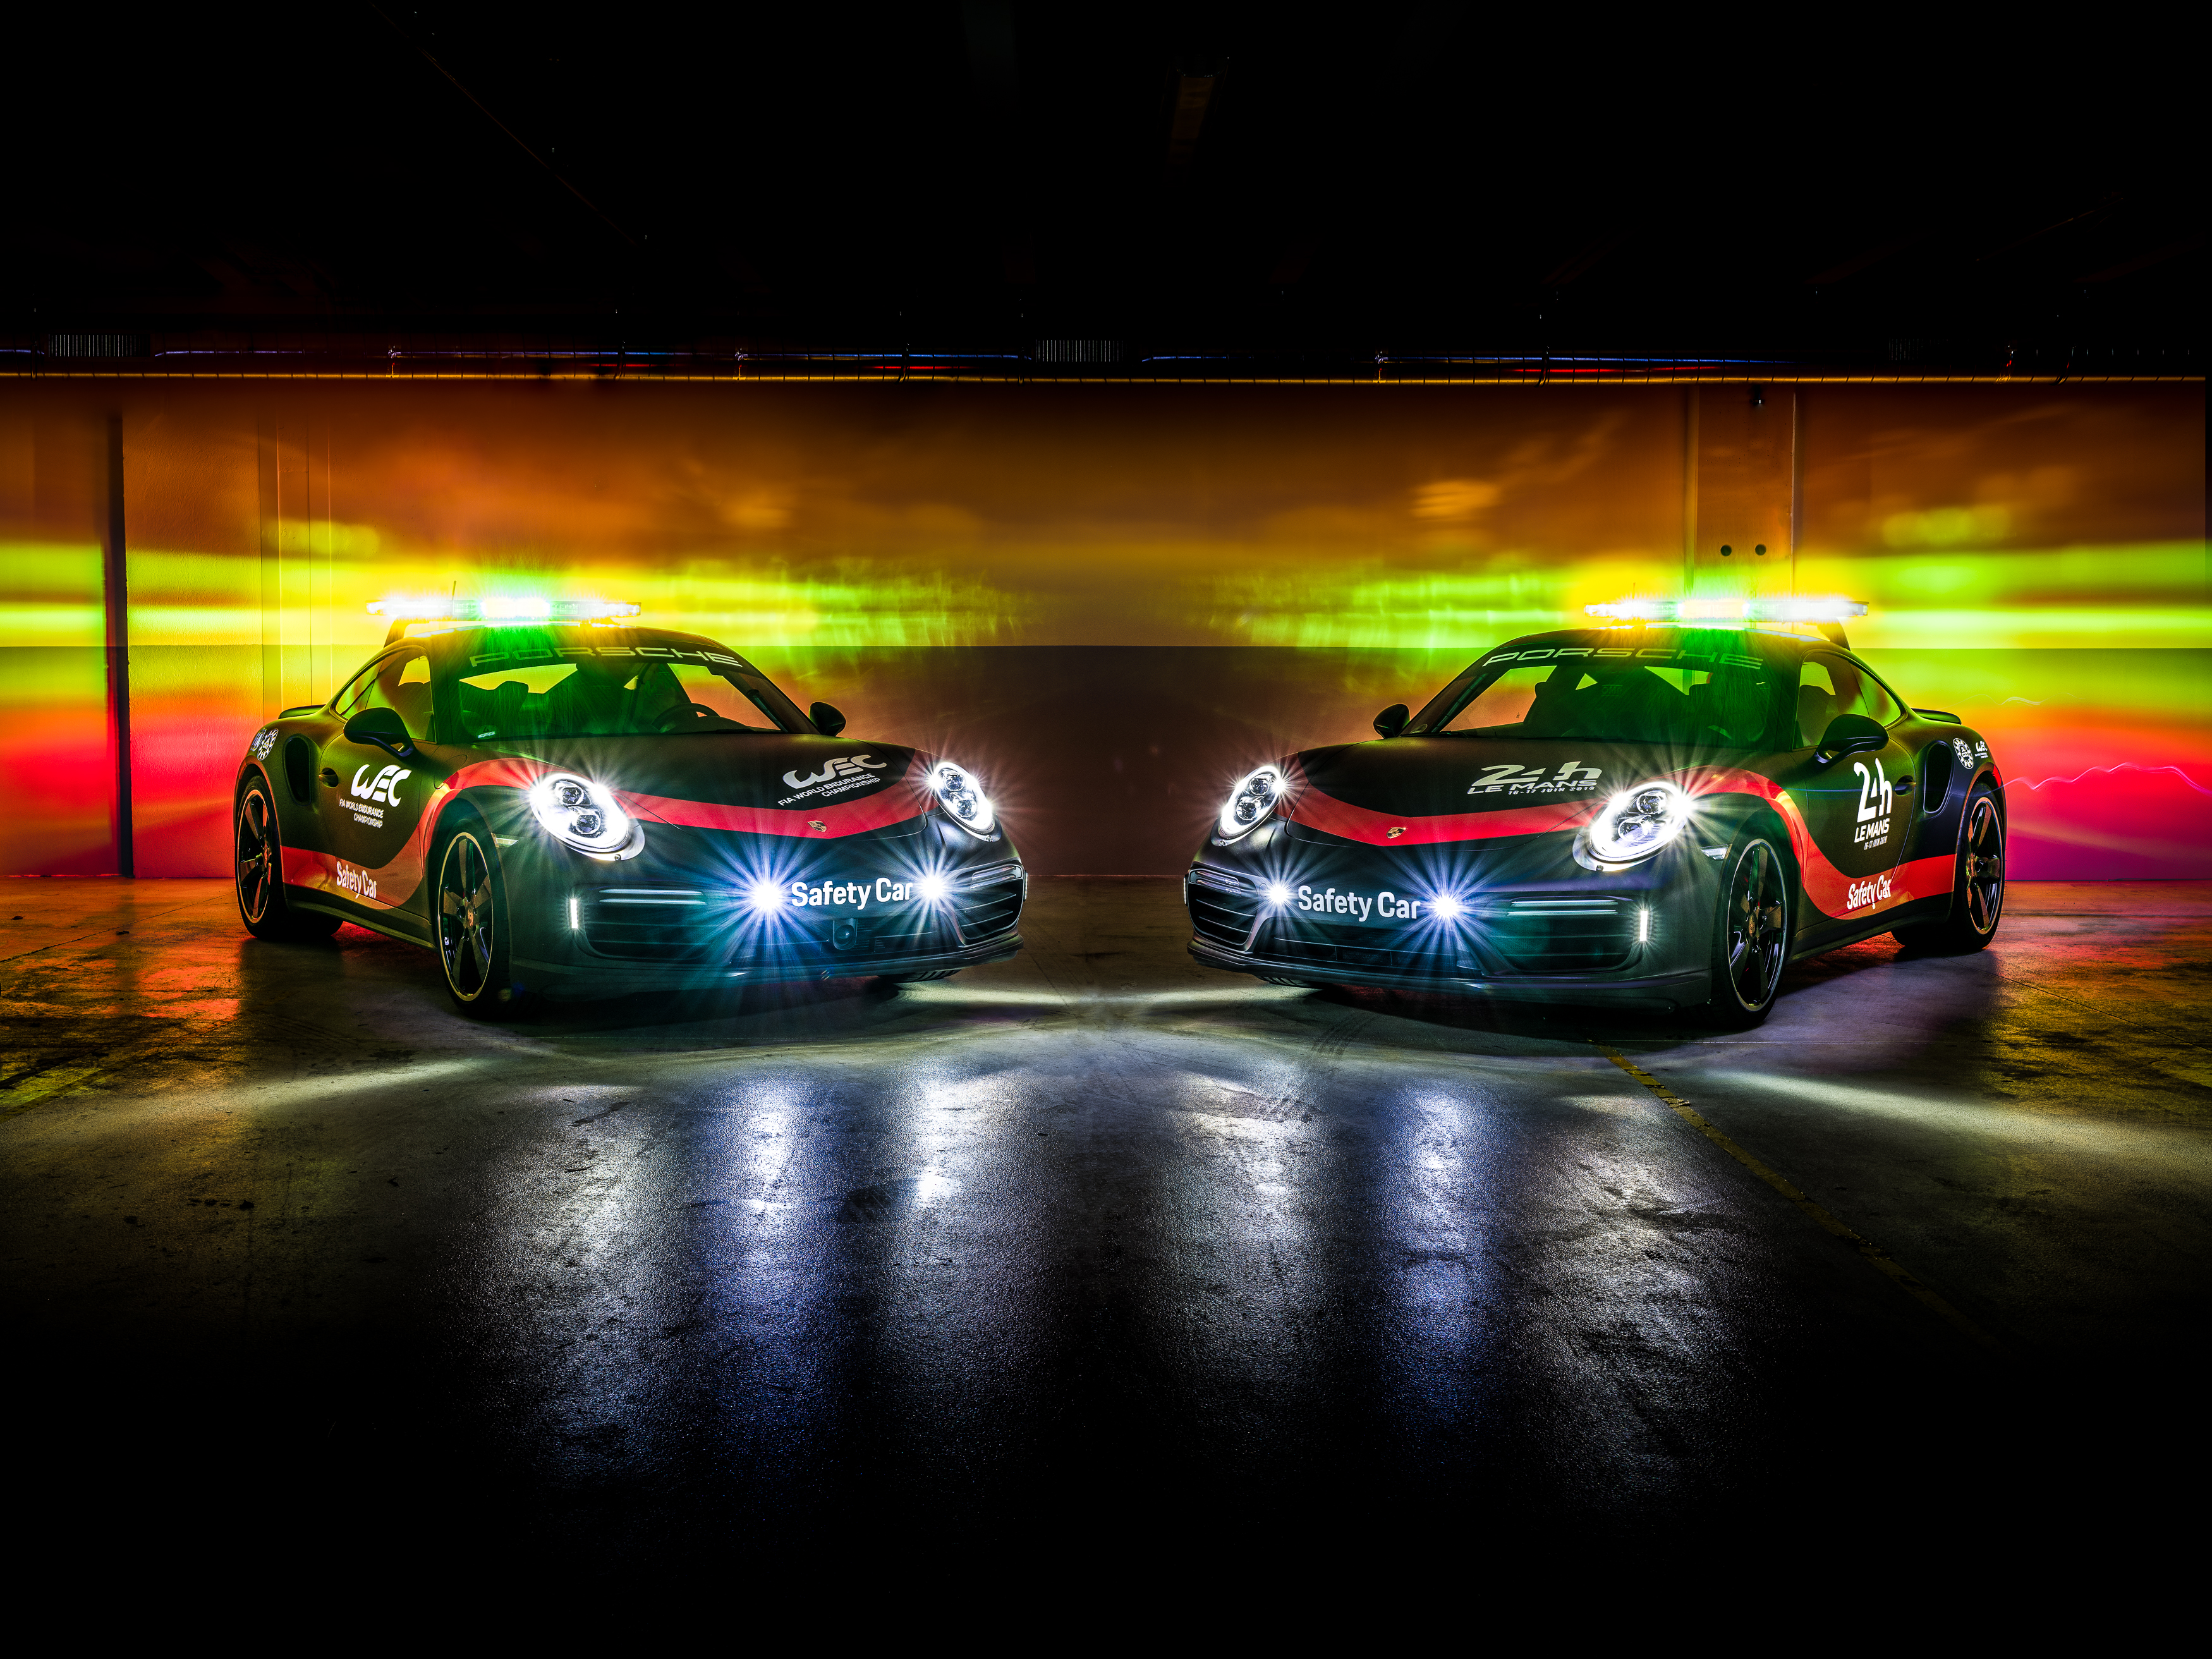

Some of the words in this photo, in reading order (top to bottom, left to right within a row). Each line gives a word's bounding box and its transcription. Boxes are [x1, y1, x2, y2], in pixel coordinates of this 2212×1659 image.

[470, 647, 743, 667] PORSCHE
[1482, 648, 1763, 669] PORSCHE
[351, 763, 412, 807] WEC
[782, 754, 887, 789] WEC
[777, 797, 796, 806] FIA
[793, 786, 825, 799] WORLD
[822, 773, 876, 790] ENDURANCE
[821, 777, 880, 797] CHAMPIONSHIP
[1467, 784, 1504, 794] LE
[1509, 780, 1598, 791] MANS
[346, 799, 359, 811] WORLD
[358, 803, 384, 818] ENDURANCE
[353, 812, 383, 829] CHAMPIONSHIP
[1854, 824, 1867, 842] LE
[1866, 818, 1890, 839] MANS
[336, 861, 362, 899] Safety
[362, 870, 377, 899] Car
[791, 880, 872, 910] Safety
[875, 877, 913, 902] Car
[1847, 880, 1877, 909] Safety
[1876, 875, 1892, 900] Car
[1297, 885, 1373, 922] Safety
[1377, 891, 1421, 919] Car
